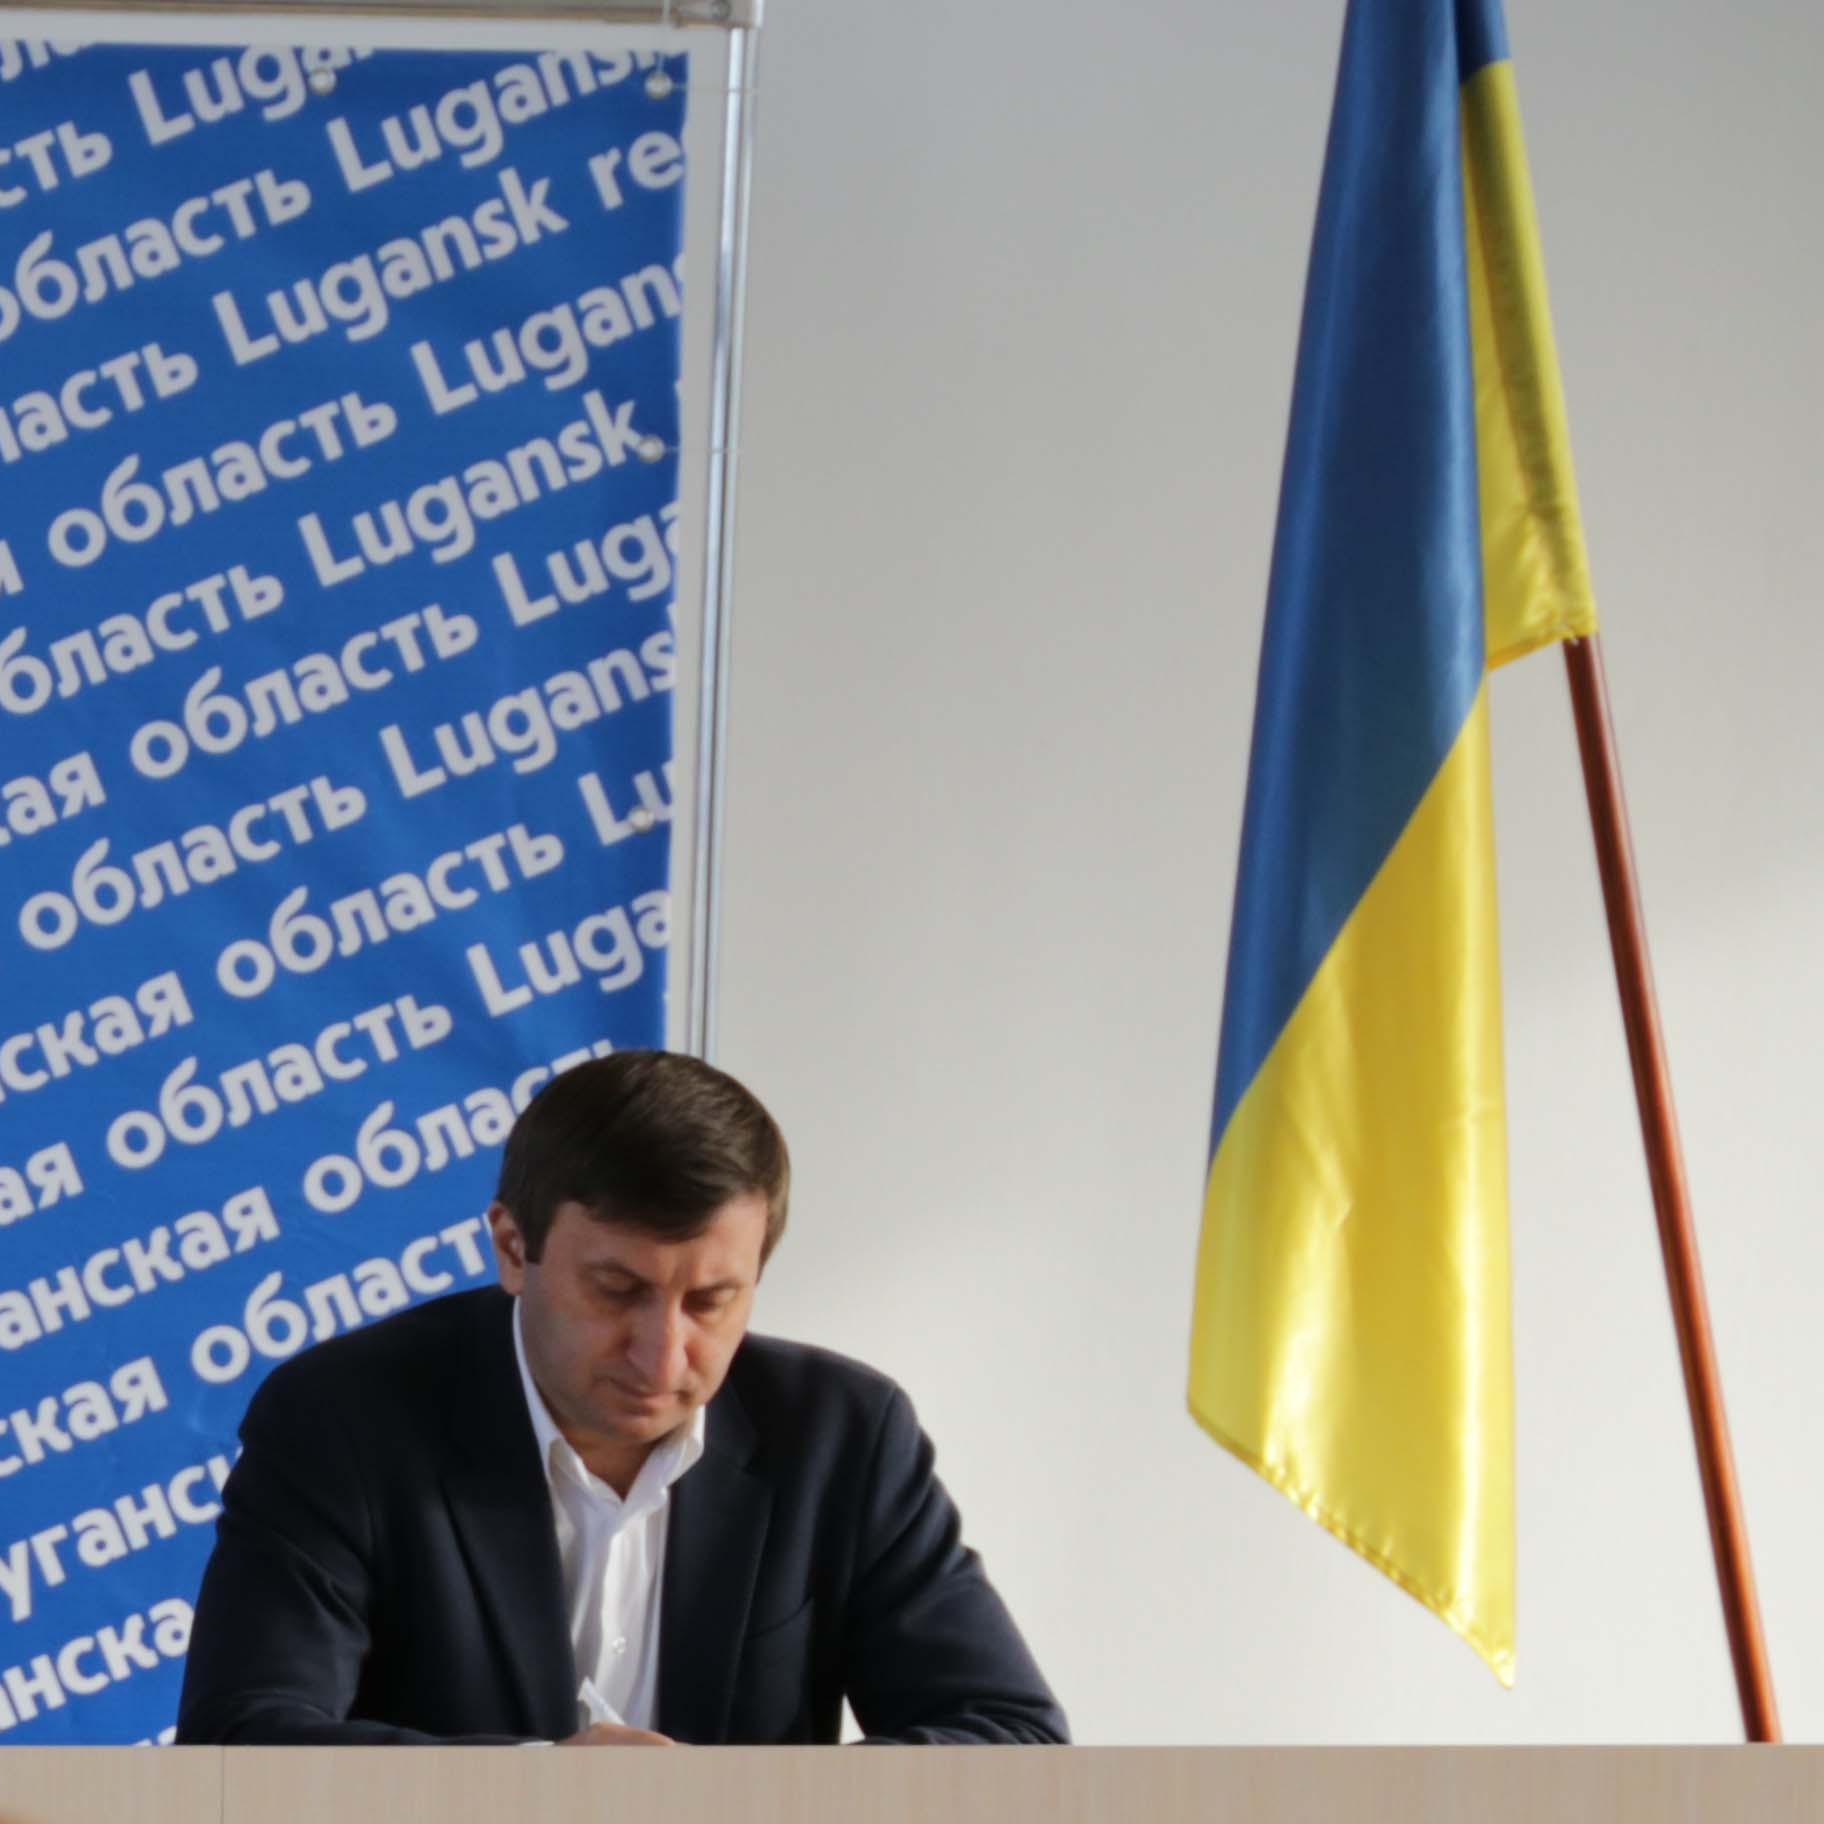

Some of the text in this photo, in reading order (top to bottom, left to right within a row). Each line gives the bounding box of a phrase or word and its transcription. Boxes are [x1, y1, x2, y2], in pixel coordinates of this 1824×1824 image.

[212, 168, 568, 365] Lugansk
[48, 393, 397, 567] область
[298, 390, 644, 587] Lugansk
[129, 604, 479, 779] область
[19, 776, 367, 951] область
[216, 824, 564, 998] область
[106, 995, 453, 1169] область
